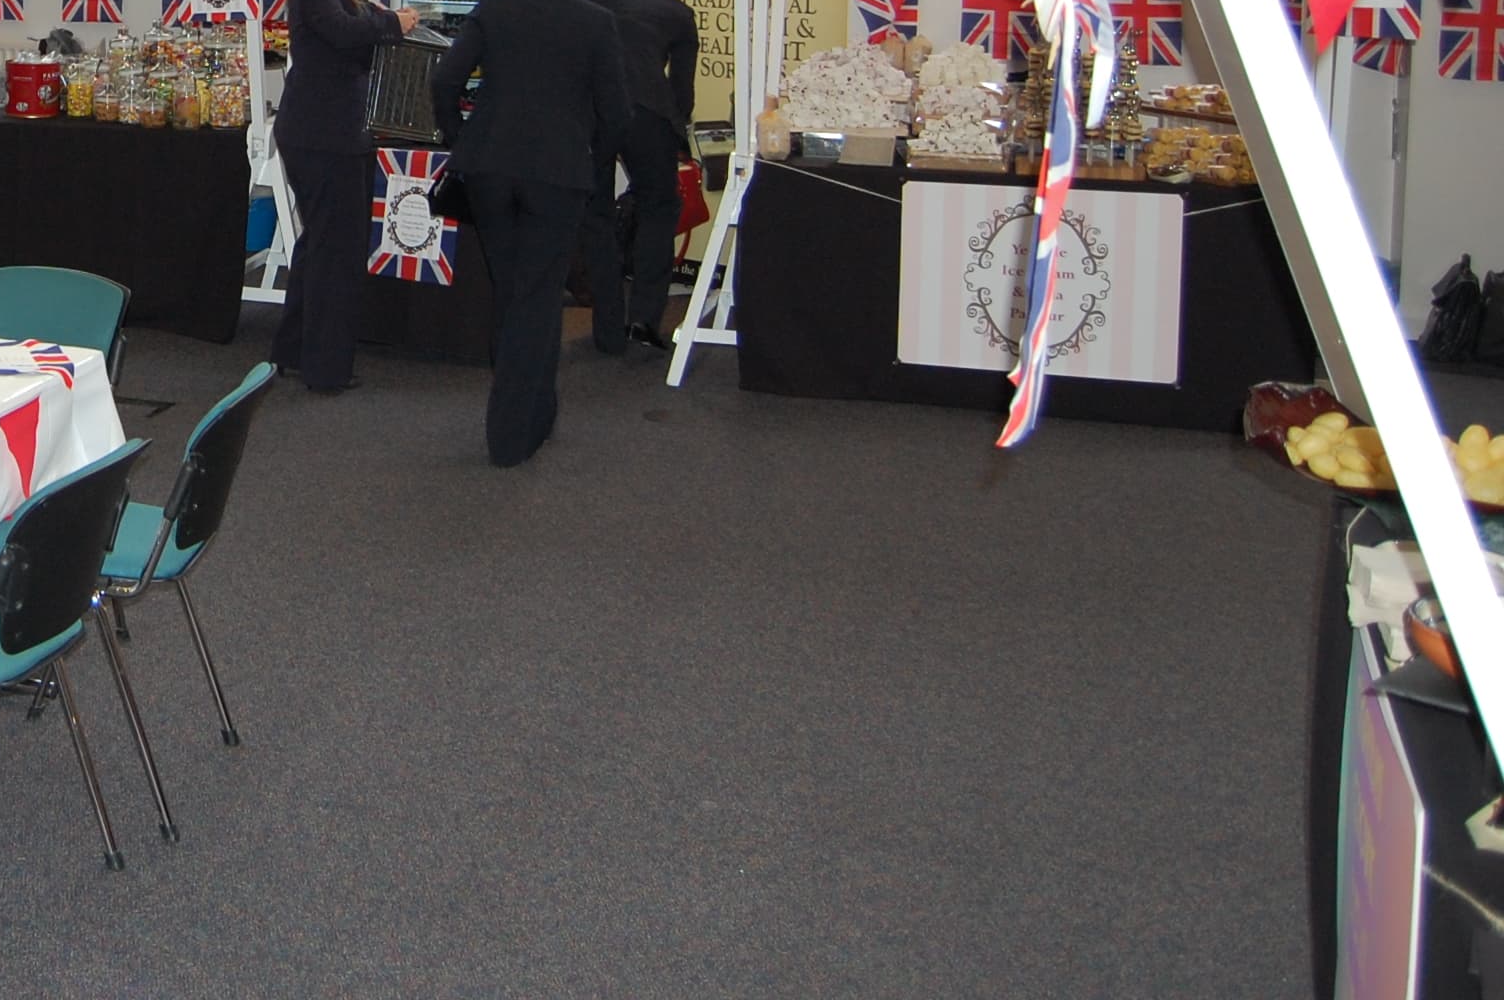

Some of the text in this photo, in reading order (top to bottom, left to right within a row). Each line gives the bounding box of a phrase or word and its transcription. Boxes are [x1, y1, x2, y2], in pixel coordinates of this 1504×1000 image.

[797, 18, 816, 39] &
[700, 36, 735, 56] EAL
[1012, 244, 1028, 256] Ye
[1002, 265, 1025, 276] Ice
[1012, 286, 1025, 298] &
